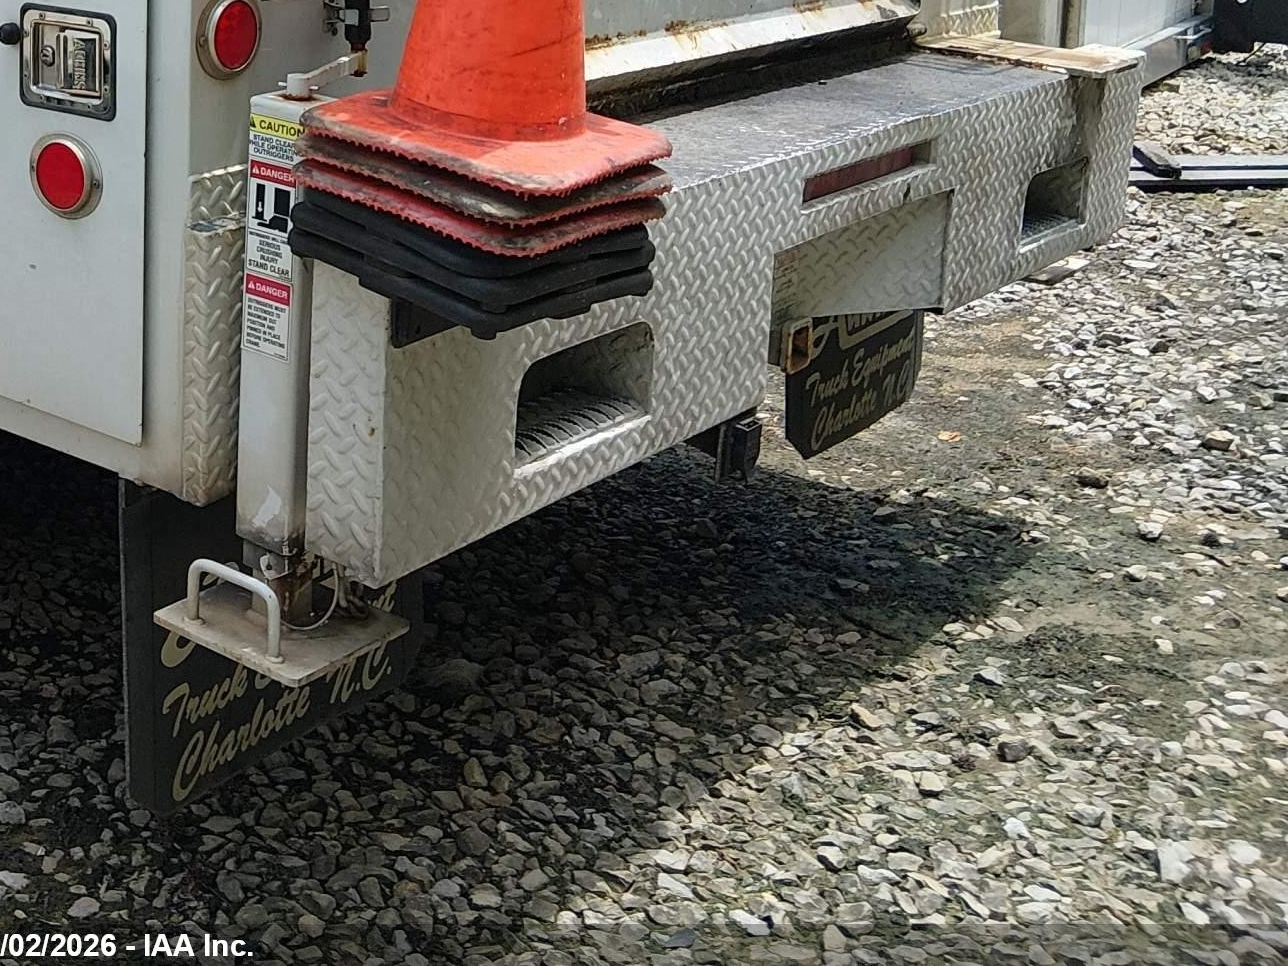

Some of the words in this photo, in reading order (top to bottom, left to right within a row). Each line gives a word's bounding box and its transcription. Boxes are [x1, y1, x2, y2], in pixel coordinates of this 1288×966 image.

[259, 119, 305, 137] CAUTION
[253, 133, 273, 144] STAND
[253, 146, 294, 162] OUTRIGGERS
[267, 143, 298, 156] OPERATIN
[256, 245, 283, 259] CRUSHING
[259, 239, 281, 251] SERIOUS
[259, 253, 278, 264] INJURY
[248, 258, 268, 271] STAND
[270, 264, 290, 277] CLEAR
[255, 281, 288, 299] DANGER
[268, 332, 280, 341] PLACE
[805, 361, 849, 407] Truck
[851, 330, 915, 388] Equipment
[810, 388, 877, 451] Charlotte
[162, 662, 249, 738] Truck
[172, 684, 313, 802] Charlotte
